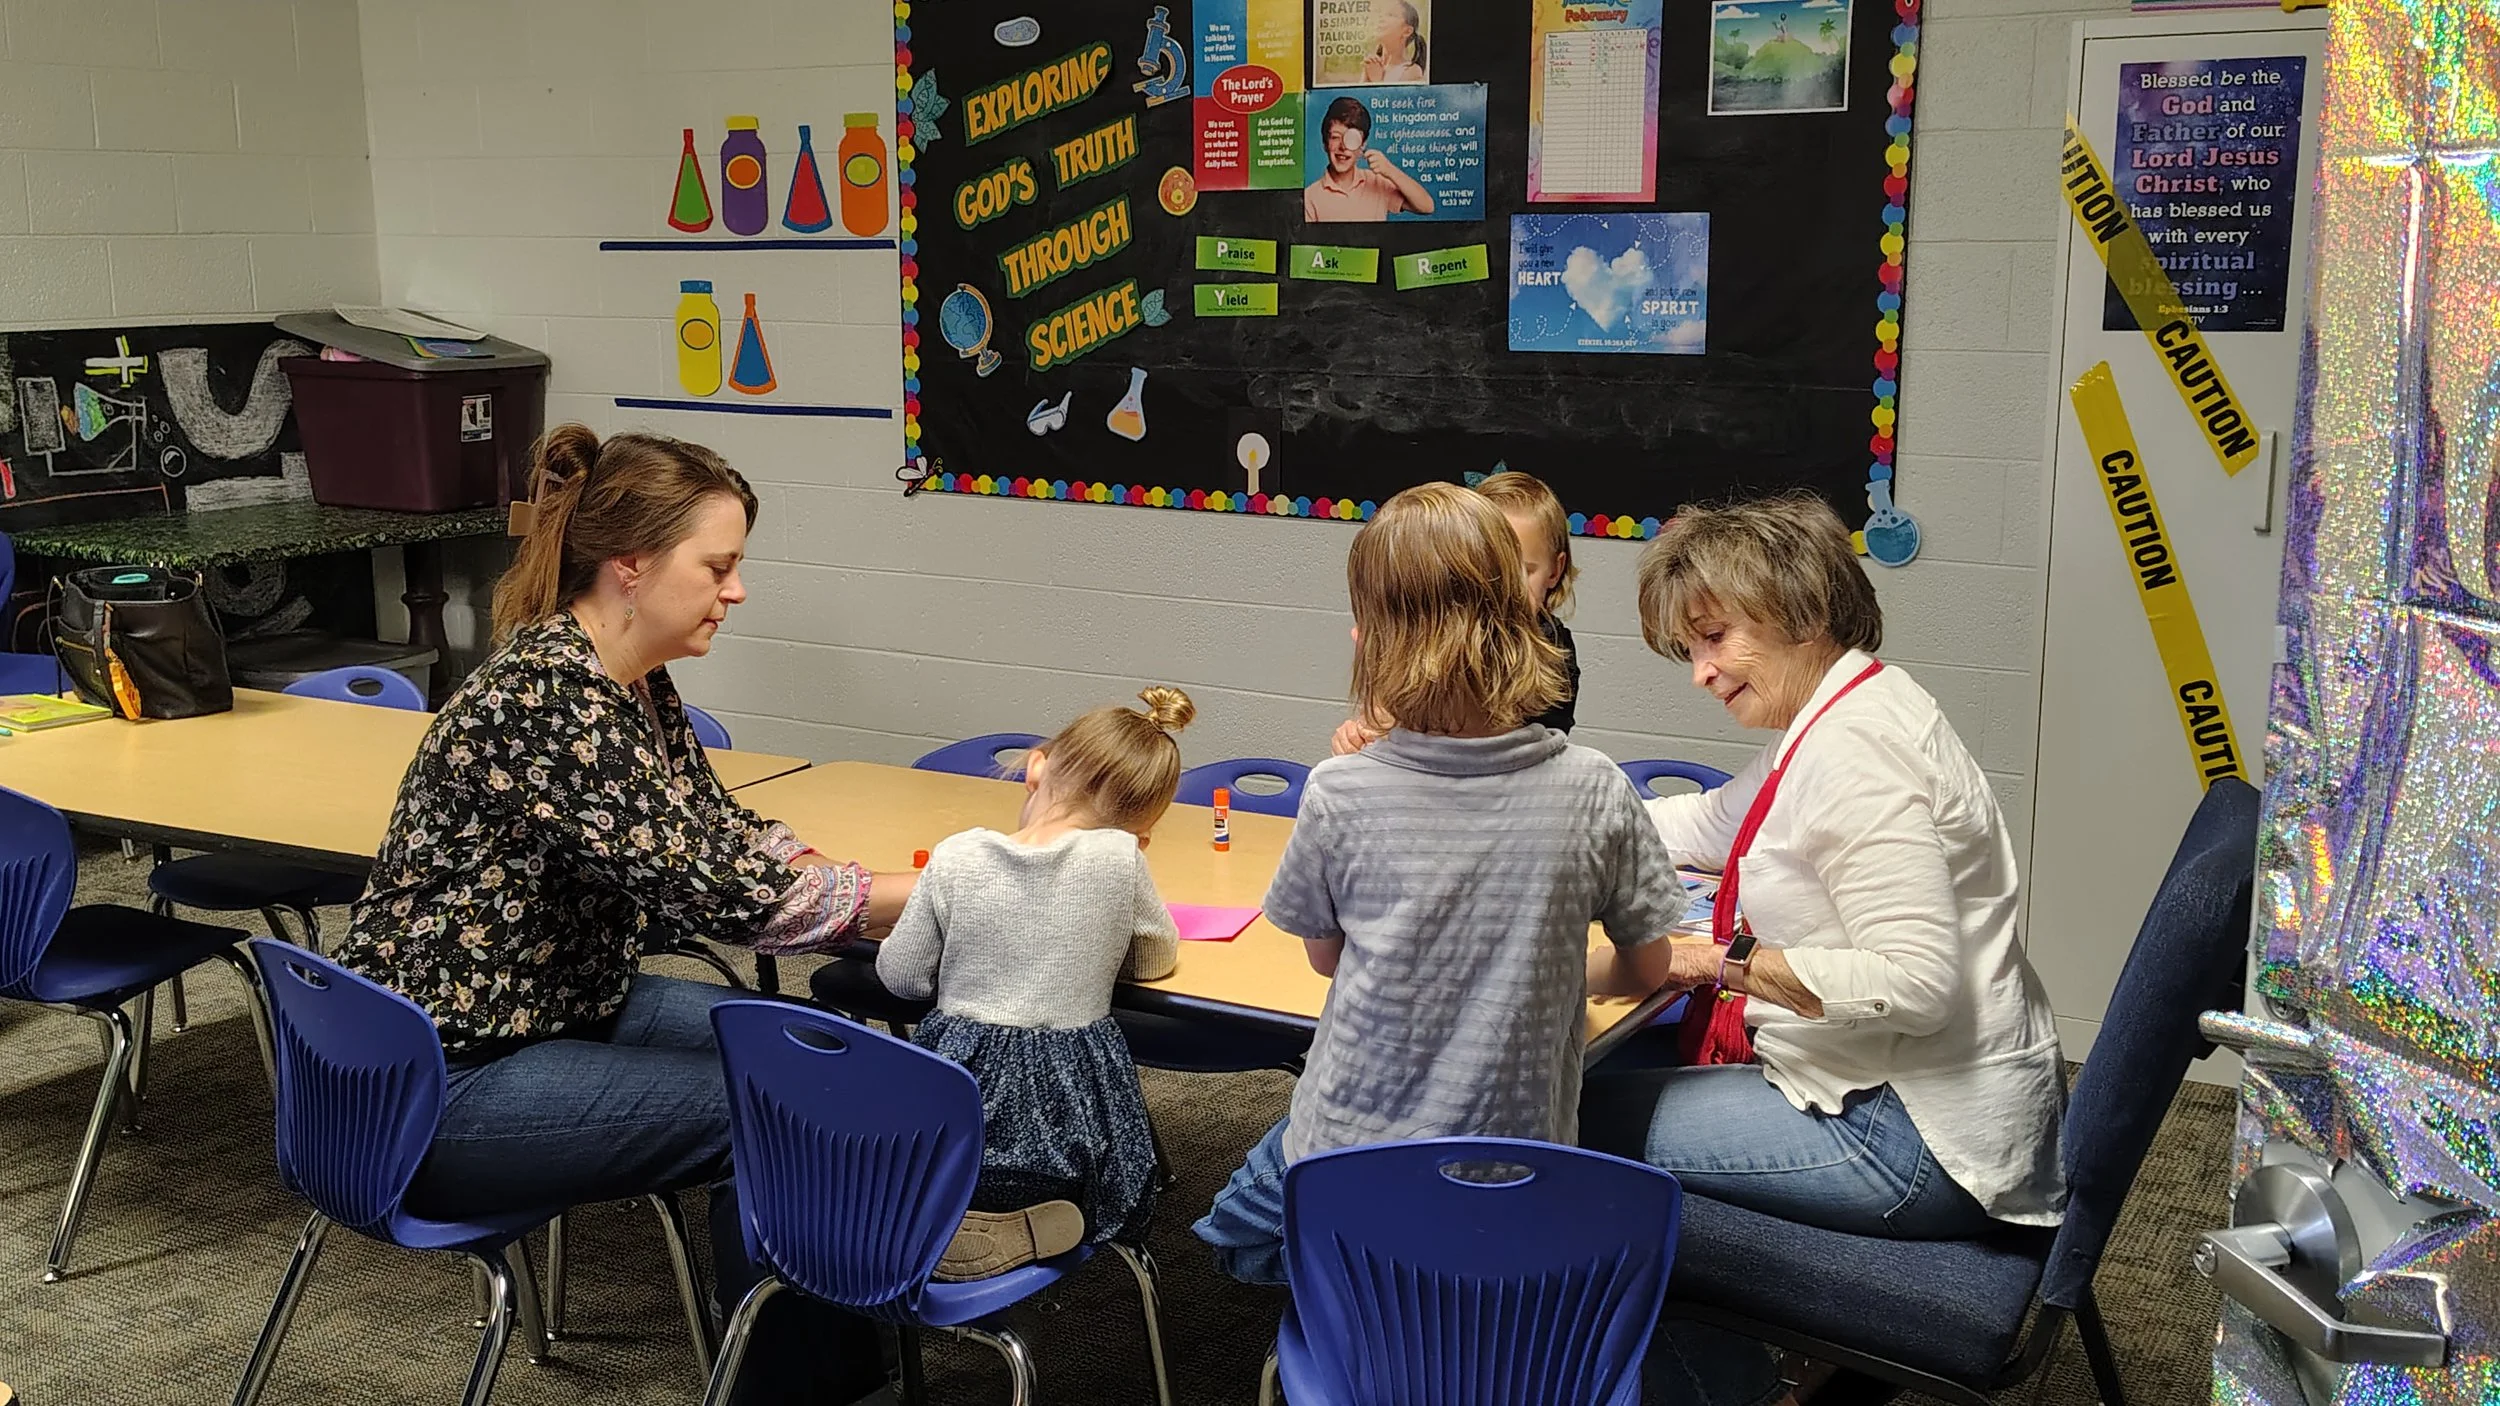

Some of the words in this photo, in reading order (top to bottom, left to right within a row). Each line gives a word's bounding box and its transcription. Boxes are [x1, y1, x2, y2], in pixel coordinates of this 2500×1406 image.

[1319, 1, 1371, 14] PRAYER
[1564, 7, 1629, 24] February
[1209, 24, 1219, 32] We
[1319, 18, 1329, 29] IS
[1330, 17, 1369, 28] SIMPLY
[1205, 34, 1227, 43] talking
[1319, 30, 1366, 42] TALKING
[1215, 44, 1236, 52] Father
[1319, 46, 1333, 55] TO
[1336, 44, 1365, 55] GOD.
[1211, 54, 1236, 62] Heaven.
[1222, 79, 1241, 91] The
[1242, 77, 1273, 90] Lord's
[2140, 71, 2213, 90] Blessed
[2220, 70, 2246, 86] be
[2252, 69, 2281, 85] the
[966, 46, 1109, 140] EXPLORING
[1231, 92, 1264, 106] Prayer
[1371, 98, 1389, 109] But
[1391, 97, 1414, 109] seek
[1417, 96, 1437, 108] first
[2161, 95, 2214, 116] God
[2219, 96, 2256, 113] and
[1208, 120, 1218, 128] We
[1218, 120, 1234, 128] trust
[1271, 118, 1284, 126] God
[1284, 117, 1294, 125] for
[1375, 113, 1389, 124] his
[1392, 112, 1437, 125] kingdom
[1439, 111, 1460, 121] and
[1204, 131, 1217, 139] God
[1225, 130, 1239, 140] give
[1258, 128, 1295, 137] forgiveness
[1375, 129, 1388, 139] his
[1455, 126, 1476, 136] and
[2132, 123, 2221, 142] Father
[2226, 123, 2247, 139] of
[2250, 125, 2284, 138] our
[1280, 138, 1294, 147] help
[1387, 143, 1399, 154] all
[1402, 143, 1426, 153] these
[1429, 142, 1458, 156] things
[1461, 141, 1478, 151] will
[1204, 150, 1220, 158] need
[1272, 148, 1290, 156] avoid
[2132, 148, 2194, 169] Lord
[2202, 148, 2280, 167] Jesus
[1205, 160, 1220, 169] daily
[1258, 158, 1296, 168] temptation.
[1402, 158, 1415, 167] be
[1418, 159, 1441, 172] given
[1444, 157, 1456, 167] to
[1459, 158, 1479, 169] you
[957, 162, 1036, 227] GOD'S
[1053, 120, 1136, 184] TRUTH
[1420, 174, 1432, 182] as
[1435, 173, 1459, 182] well.
[2136, 174, 2224, 197] Christ,
[2231, 176, 2271, 191] who
[1438, 190, 1475, 198] MATTHEW
[2130, 203, 2163, 219] has
[2169, 202, 2243, 218] blessed
[2249, 204, 2272, 217] us
[2148, 229, 2188, 244] with
[2194, 231, 2250, 247] every
[1003, 199, 1130, 294] THROUGH
[1216, 241, 1255, 262] Praise
[1311, 251, 1339, 269] Ask
[1417, 257, 1467, 276] Repent
[1518, 260, 1532, 271] you
[1534, 260, 1539, 268] a
[1518, 271, 1562, 286] HEART
[1214, 289, 1248, 306] Yield
[1641, 300, 1700, 315] SPIRIT
[2158, 305, 2211, 315] Ephesians
[2213, 305, 2229, 313] 1:3
[1030, 282, 1140, 368] SCIENCE
[2156, 320, 2256, 459] CAUTION
[2102, 450, 2177, 591] CAUTION
